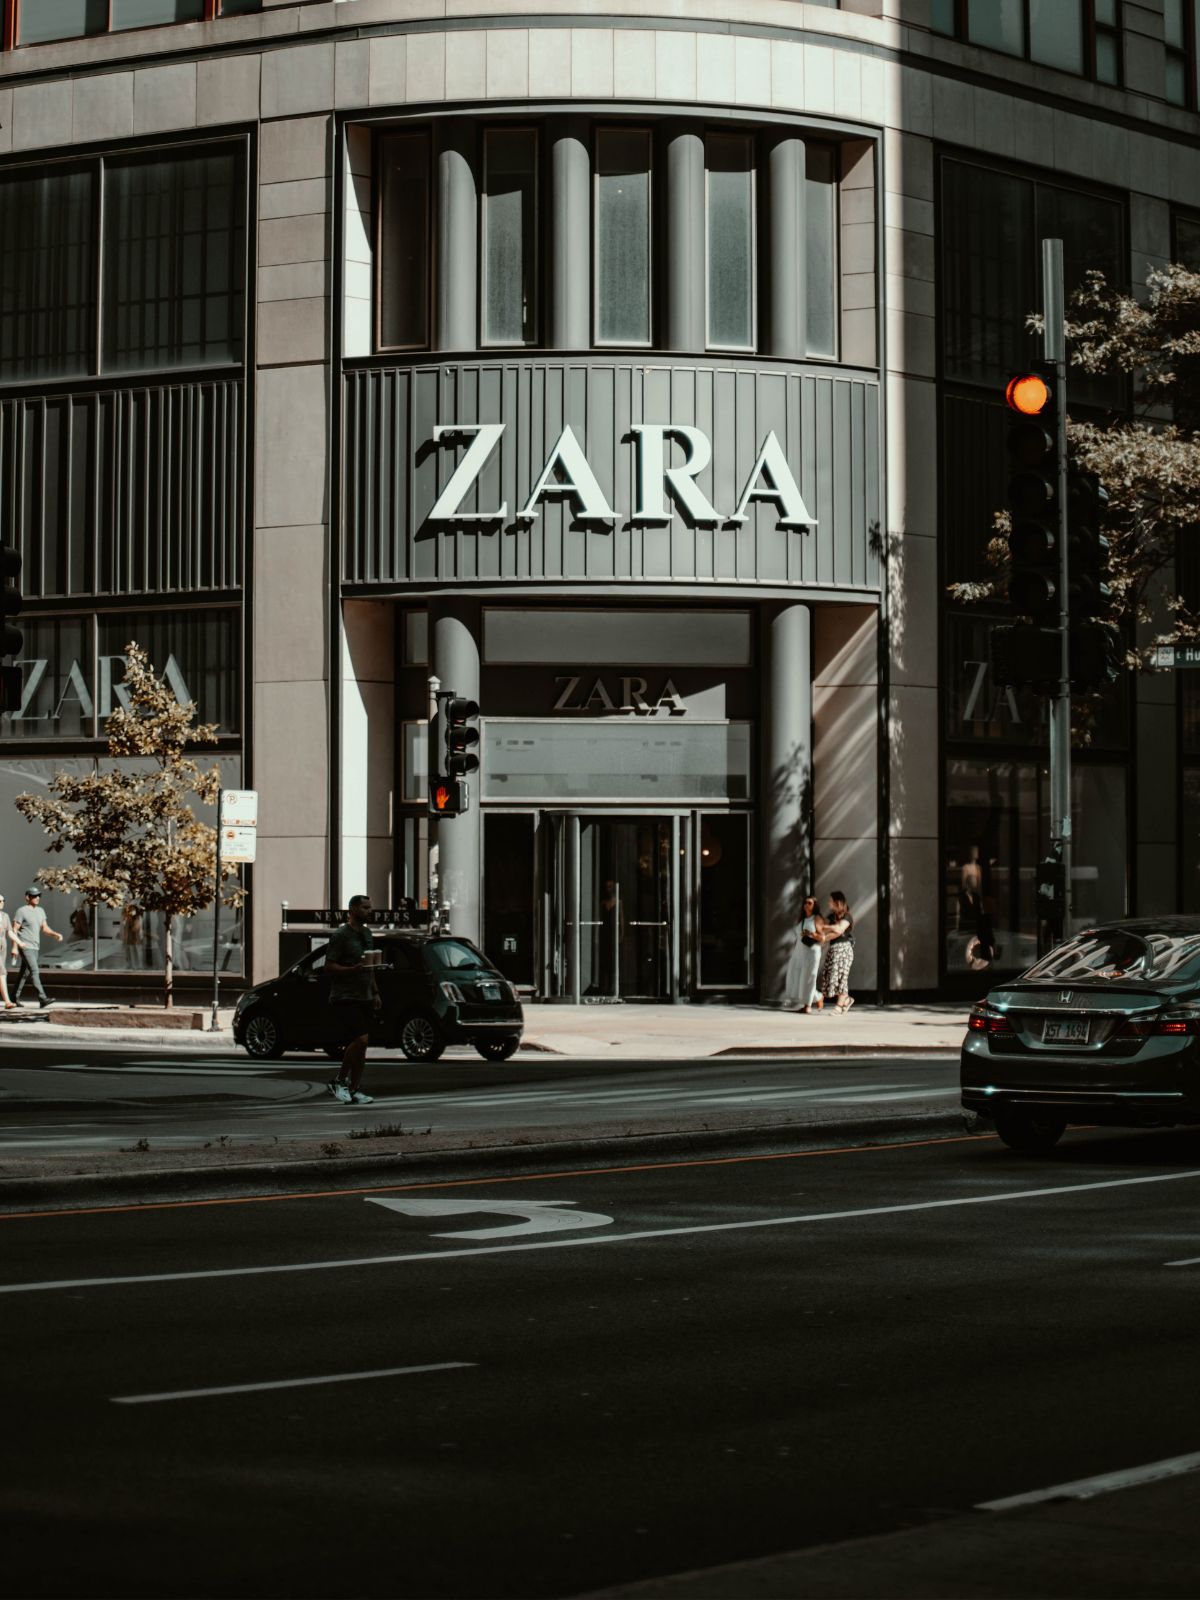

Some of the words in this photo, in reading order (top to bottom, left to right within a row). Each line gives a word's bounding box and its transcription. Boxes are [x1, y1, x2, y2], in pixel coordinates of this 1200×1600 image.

[428, 424, 818, 525] ZARA
[11, 653, 198, 721] ZARA
[553, 676, 689, 711] ZARA
[962, 660, 1050, 724] ZA
[314, 911, 410, 922] NEWPERS
